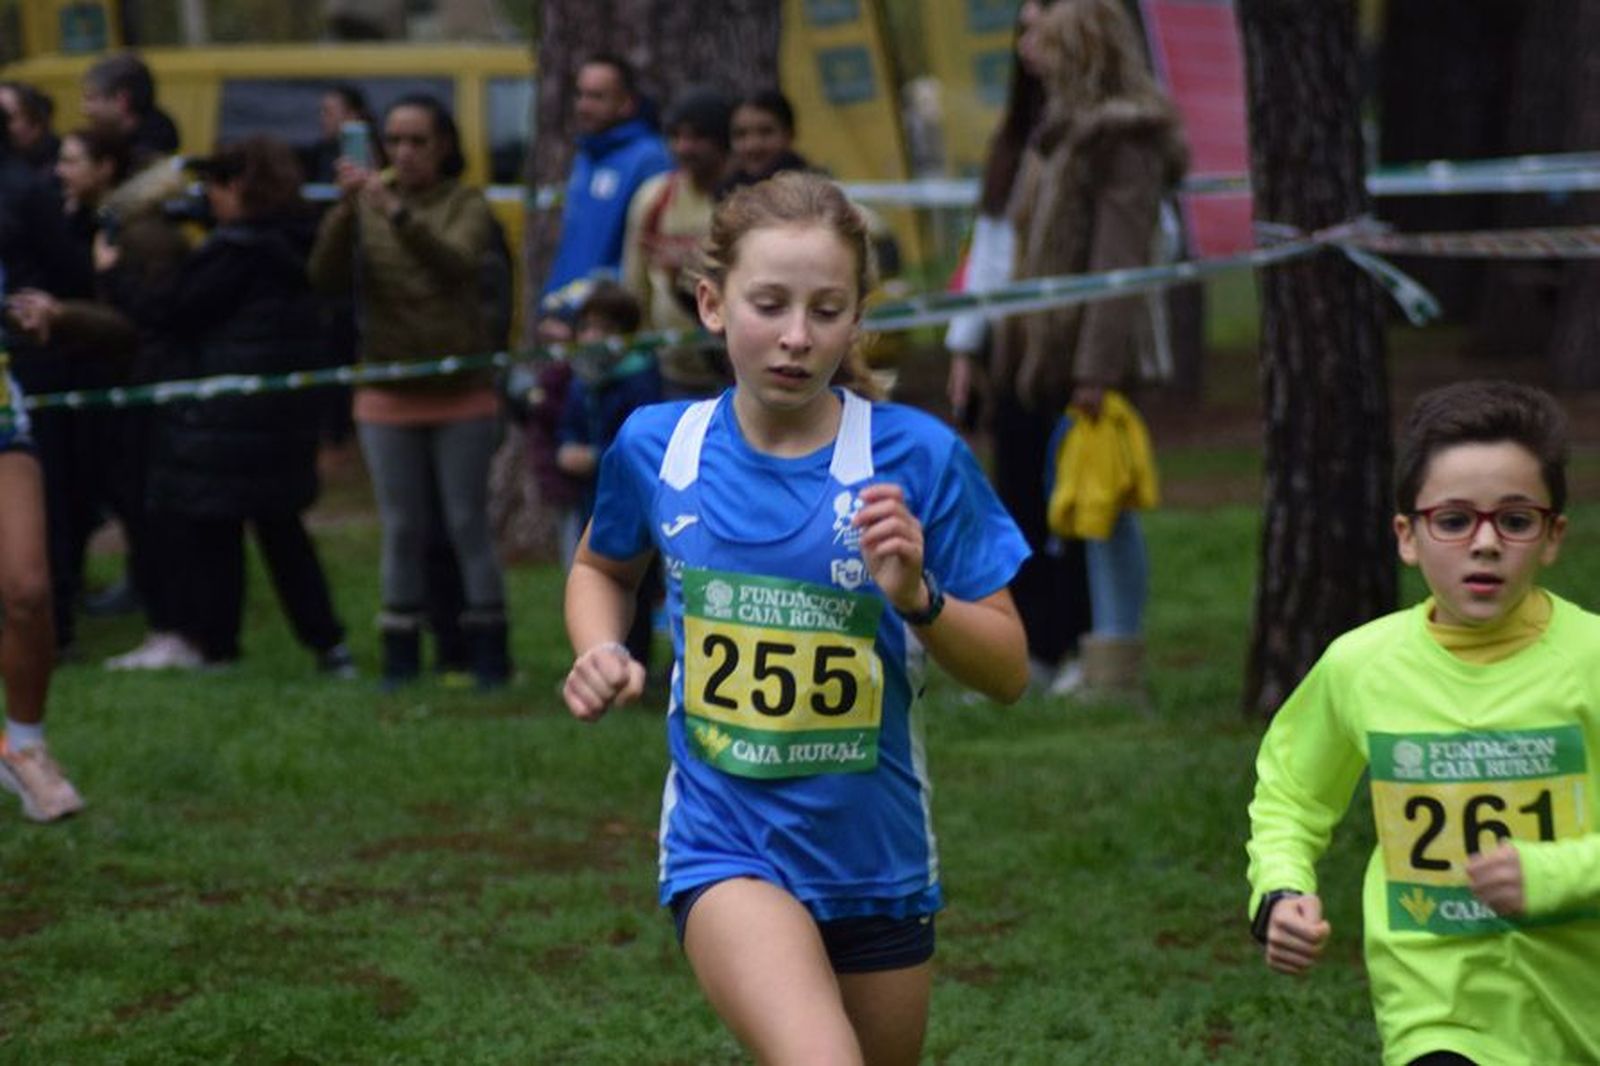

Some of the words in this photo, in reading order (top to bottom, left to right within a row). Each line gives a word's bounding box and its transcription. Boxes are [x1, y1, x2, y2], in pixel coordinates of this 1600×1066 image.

[738, 604, 783, 626] CAJA
[702, 633, 858, 716] 255
[732, 740, 782, 764] CAJA
[788, 738, 866, 763] RURAL
[1430, 761, 1480, 778] CAJA
[1485, 759, 1558, 777] RURAL
[1404, 789, 1556, 871] 261
